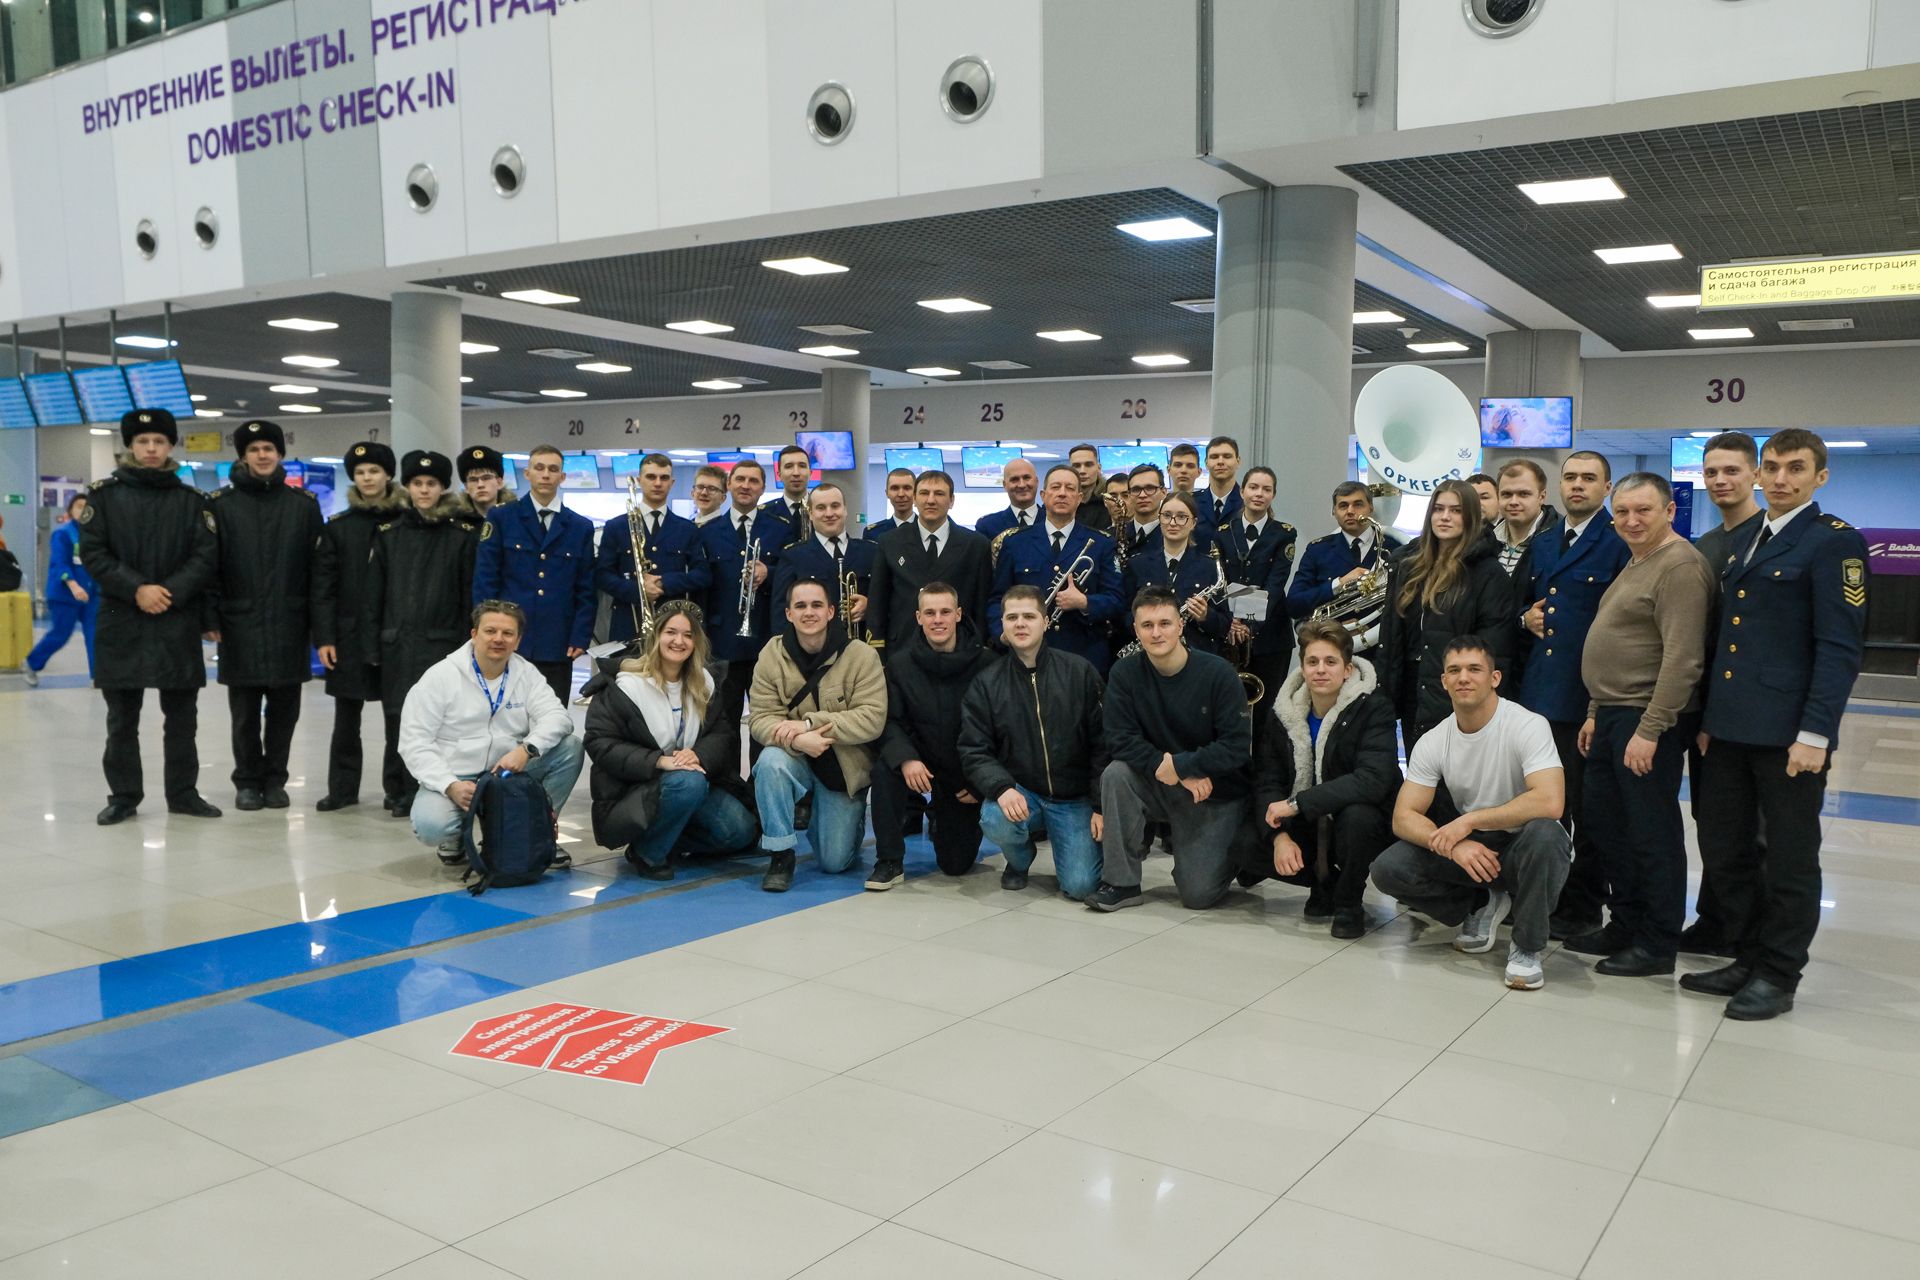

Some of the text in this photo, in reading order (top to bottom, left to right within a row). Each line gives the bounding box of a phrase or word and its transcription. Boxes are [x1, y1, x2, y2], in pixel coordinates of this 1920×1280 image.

[82, 65, 225, 135] ВНУТРЕННИЕ
[230, 28, 355, 94] ВЫЛЕТЫ.
[188, 67, 456, 165] DOMESTIC CHECK-IN
[1708, 259, 1917, 281] Самостоятельная регистрация
[1708, 277, 1806, 291] и сдача багажа
[1790, 285, 1833, 298] Baggage
[1835, 286, 1859, 297] Drop
[1861, 284, 1877, 294] Off
[1706, 377, 1745, 404] 30
[903, 405, 925, 425] 24
[980, 403, 1004, 423] 25
[1121, 398, 1148, 419] 26
[568, 420, 584, 436] 20
[625, 418, 640, 434] 21
[722, 413, 741, 431] 22
[789, 411, 809, 429] 23
[488, 423, 501, 438] 19
[559, 1019, 658, 1069] Express train
[584, 1020, 687, 1075] to Vladivostok
